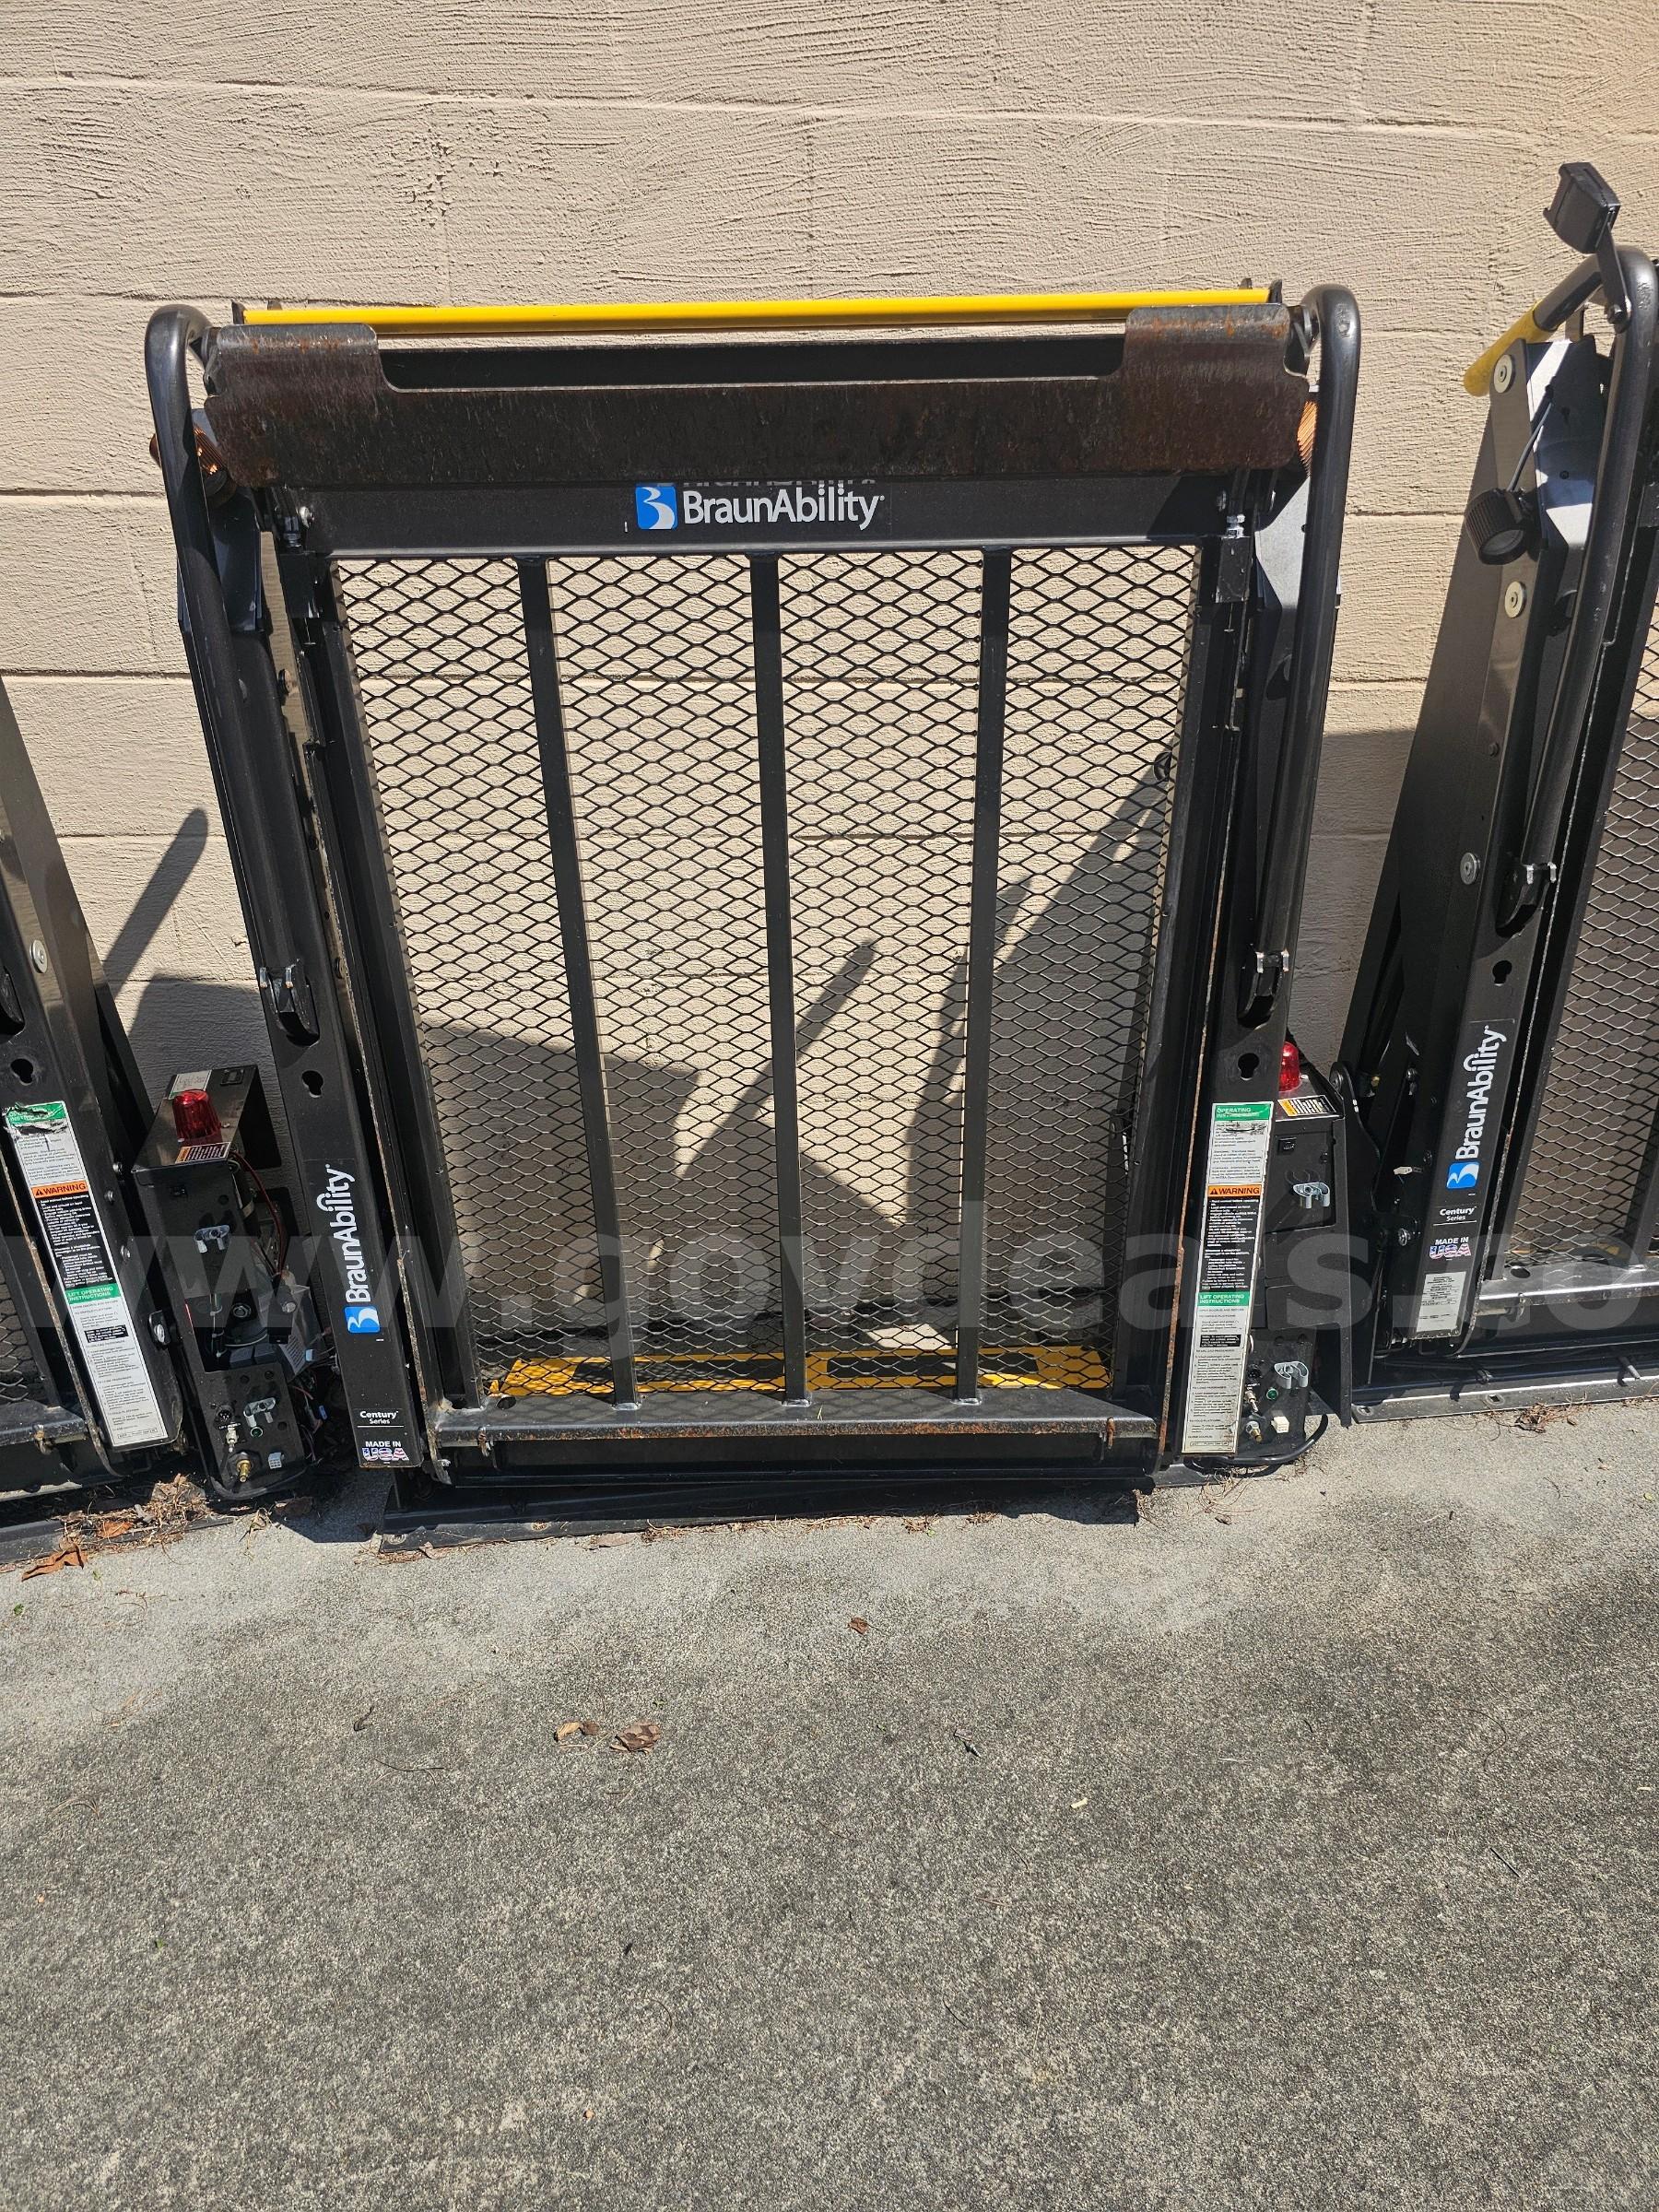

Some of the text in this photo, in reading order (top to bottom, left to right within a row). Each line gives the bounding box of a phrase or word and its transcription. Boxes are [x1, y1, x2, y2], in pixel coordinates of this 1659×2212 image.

[683, 486, 881, 531] BraunAbility
[1455, 1025, 1507, 1160] BraunAbility
[43, 1182, 87, 1195] WARNING
[1218, 1187, 1260, 1195] WARNING
[317, 1163, 371, 1303] BraunAbility
[1434, 1237, 1459, 1245] MADE
[1430, 1243, 1472, 1259] USA
[361, 1447, 410, 1462] USA
